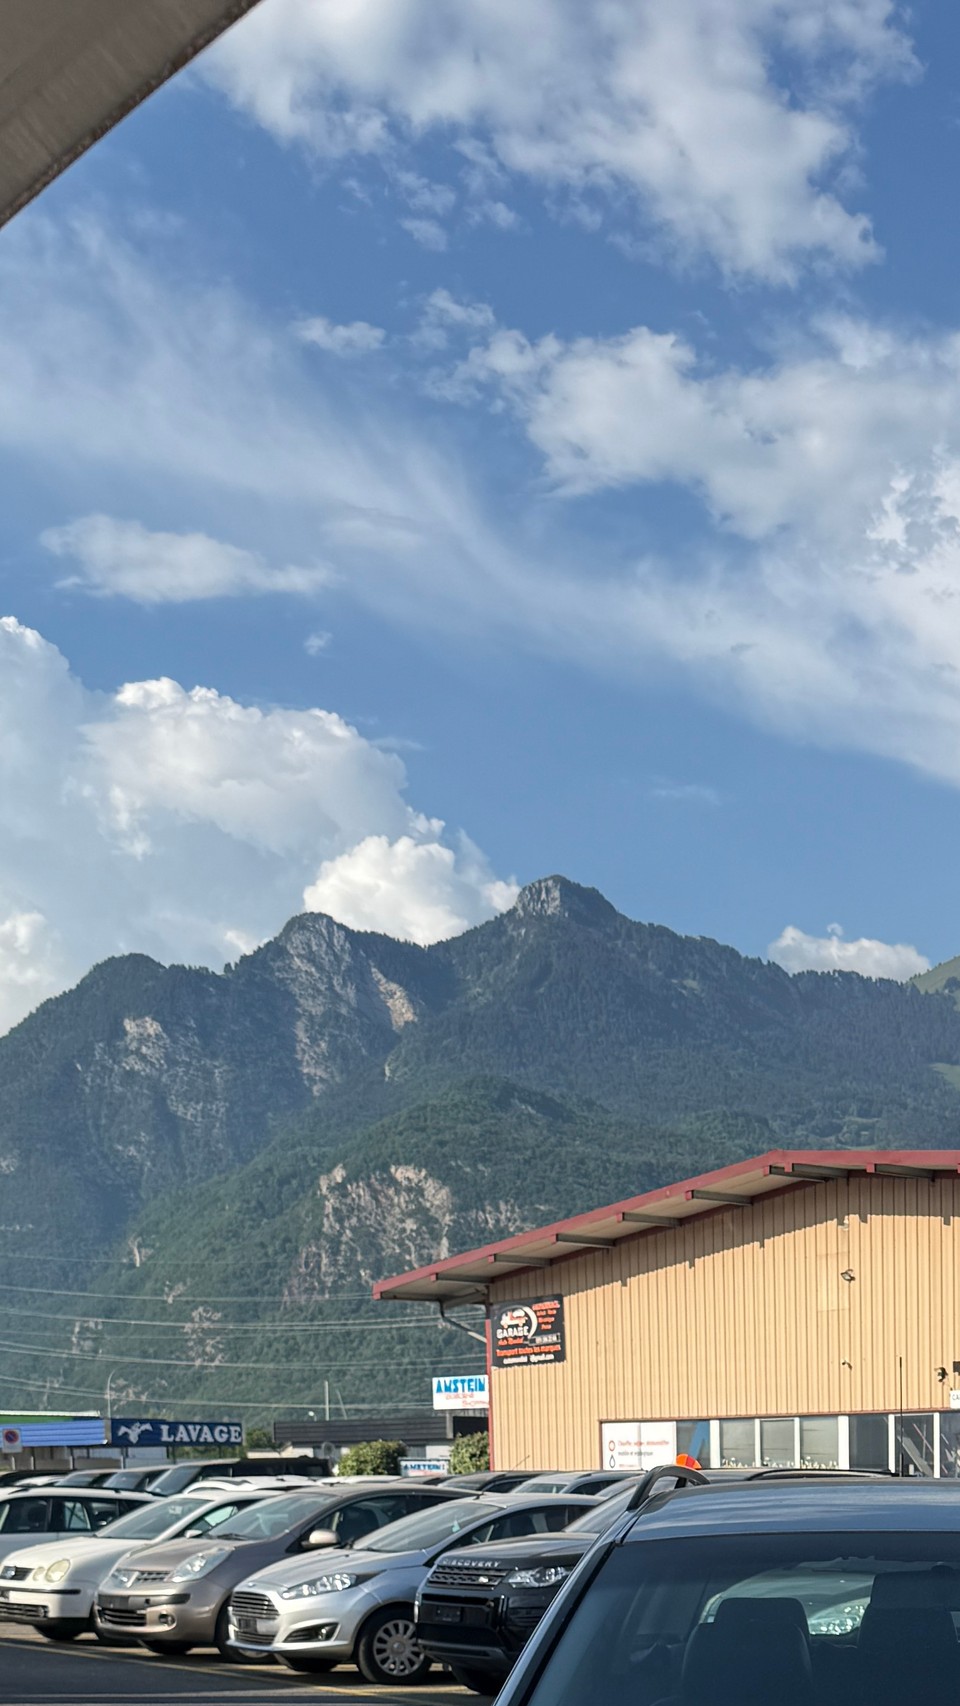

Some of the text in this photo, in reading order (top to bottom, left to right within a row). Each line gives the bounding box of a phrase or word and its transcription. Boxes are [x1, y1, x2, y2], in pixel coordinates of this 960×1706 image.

[496, 1325, 530, 1339] GARAGE
[436, 1377, 486, 1393] AMSTEIN
[160, 1425, 241, 1442] LAVAGE
